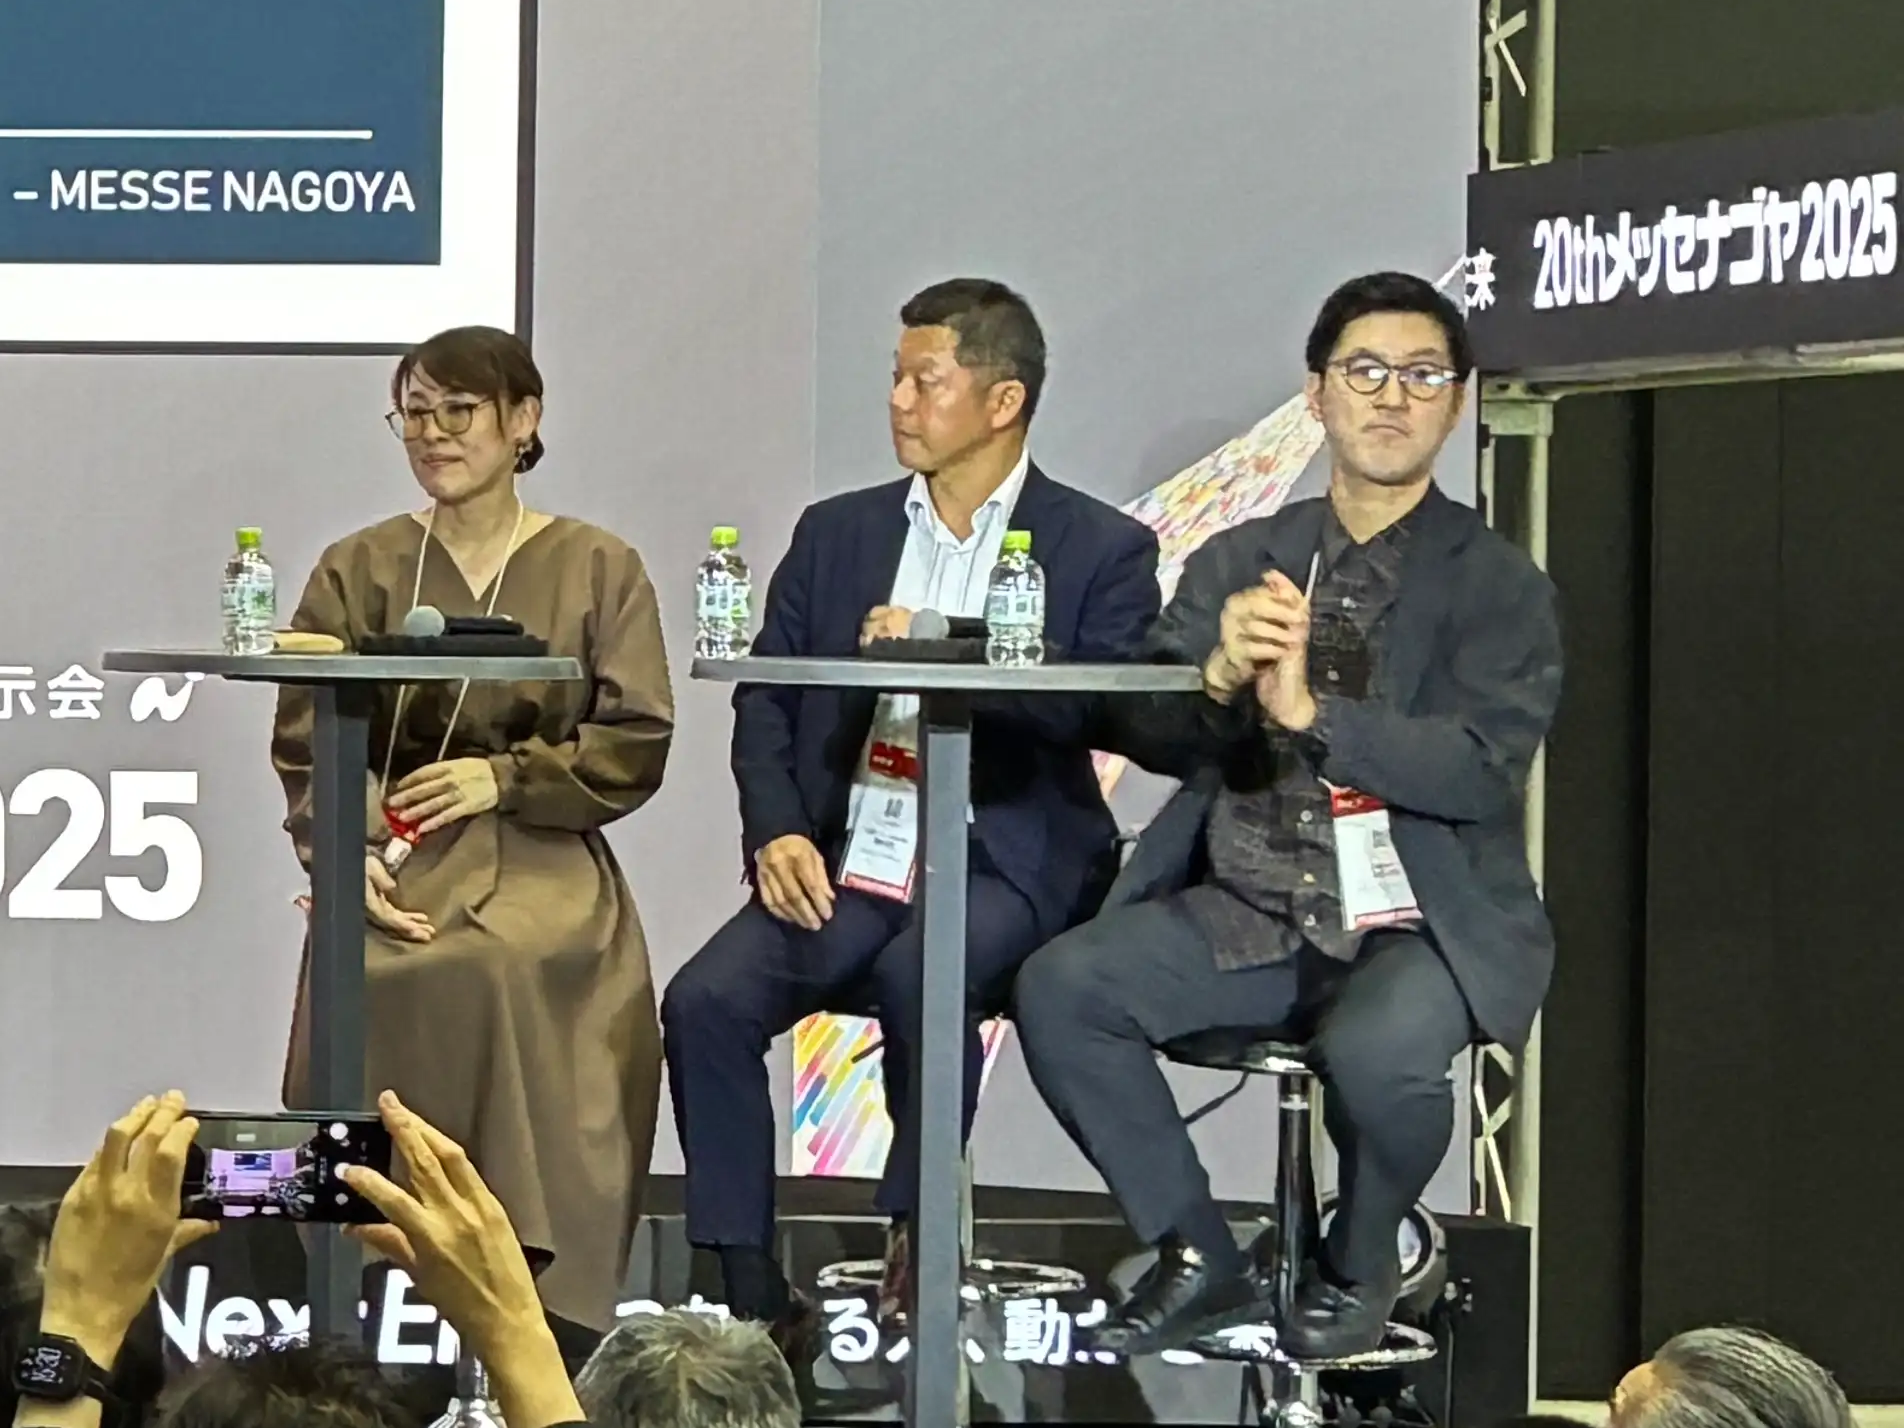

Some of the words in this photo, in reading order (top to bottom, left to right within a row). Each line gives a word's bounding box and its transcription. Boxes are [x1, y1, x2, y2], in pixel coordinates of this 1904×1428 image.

[50, 169, 213, 212] MESSE
[223, 170, 416, 213] NAGOYA
[1533, 171, 1897, 309] 20thメッセナゴヤ2025
